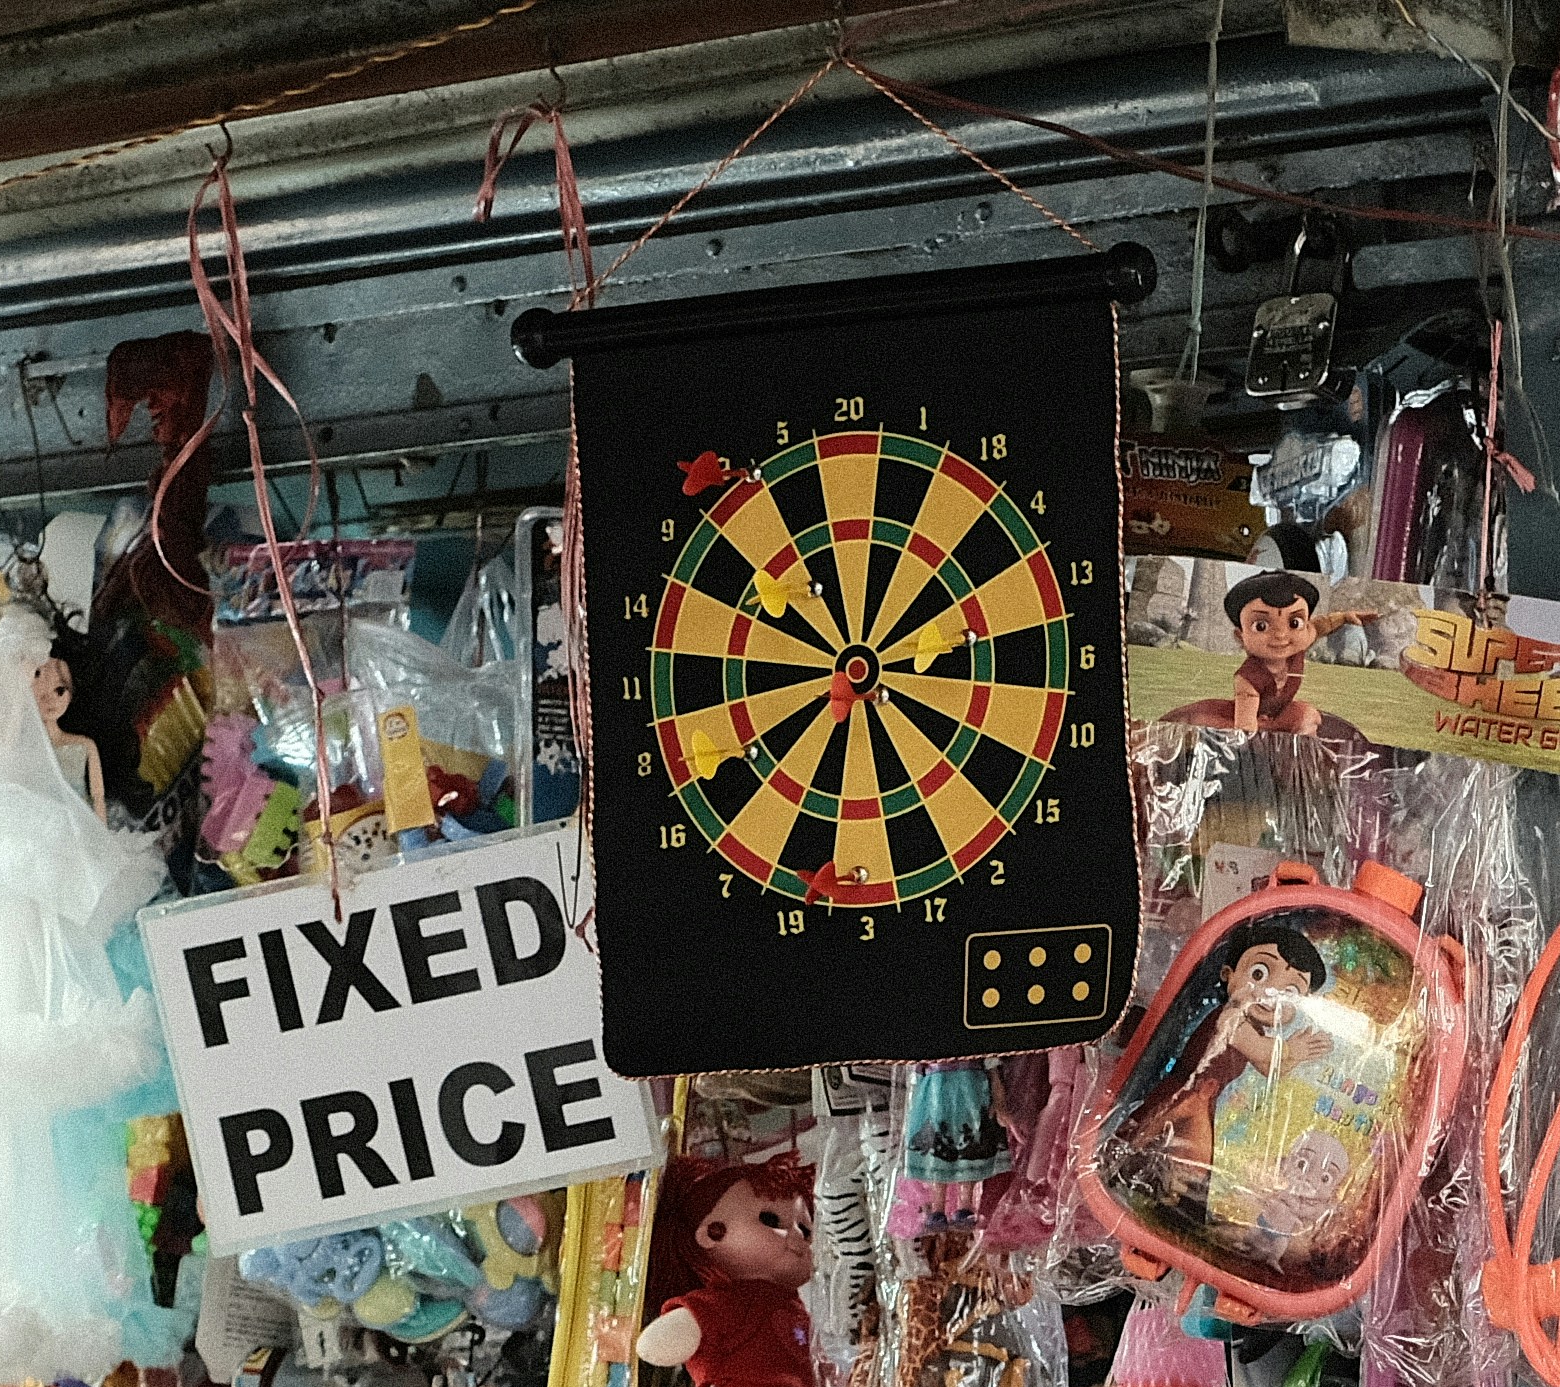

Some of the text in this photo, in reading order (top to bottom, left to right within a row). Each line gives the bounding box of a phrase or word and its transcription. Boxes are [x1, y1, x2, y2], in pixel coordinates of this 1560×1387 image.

[834, 396, 864, 422] 20
[918, 407, 928, 431] 1
[776, 421, 789, 445] 5
[979, 433, 1007, 461] 18
[1029, 490, 1046, 515] 4
[660, 518, 676, 542] 9
[1069, 560, 1094, 586] 13
[623, 593, 649, 620] 14
[1080, 644, 1096, 670] 6
[623, 677, 642, 700] 11
[1070, 722, 1096, 748] 10
[1434, 711, 1533, 747] WATER
[637, 752, 652, 777] 8
[1035, 798, 1061, 824] 15
[659, 823, 686, 849] 16
[718, 872, 735, 898] 7
[989, 859, 1006, 886] 2
[777, 909, 805, 936] 19
[924, 897, 947, 923] 17
[859, 915, 875, 941] 3
[184, 877, 566, 1048] FIXED
[220, 1040, 616, 1216] PRICE
